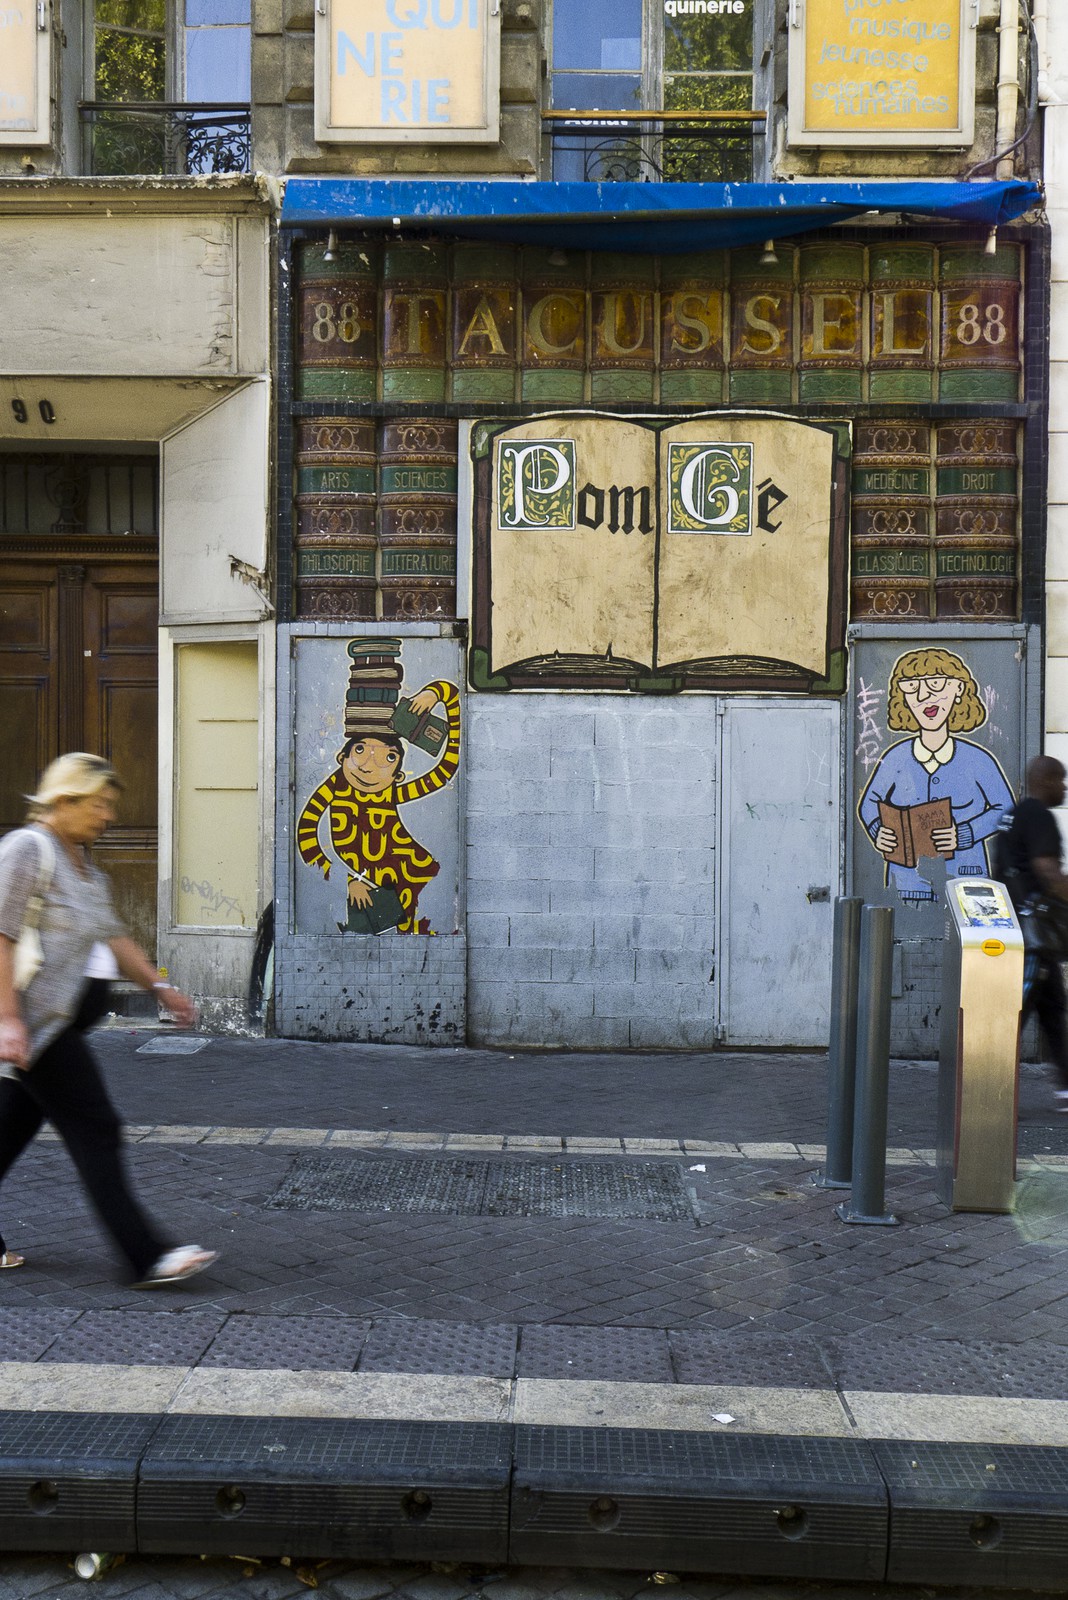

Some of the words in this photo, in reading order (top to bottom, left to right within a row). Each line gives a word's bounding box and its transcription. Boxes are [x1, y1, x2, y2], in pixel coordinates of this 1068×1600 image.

[385, 0, 479, 30] QUI
[664, 0, 745, 17] quinerie
[850, 16, 951, 45] musique
[336, 30, 404, 77] NE
[818, 37, 929, 73] jeunesse
[811, 76, 919, 101] sciences
[380, 78, 451, 123] RIE
[834, 94, 950, 116] humaines
[311, 302, 361, 343] 88
[393, 290, 928, 356] TACUSSEL
[956, 303, 1007, 345] 88
[321, 472, 350, 489] ARTS
[394, 471, 447, 488] SCIENCES
[865, 473, 918, 490] MEDECINE
[962, 473, 995, 490] DROIT
[301, 554, 370, 572] PHILOSOPHIE
[385, 554, 455, 572] LITTERATURE
[857, 555, 924, 572] CLASSIQUES
[940, 555, 1014, 572] TECHNOLOGIE
